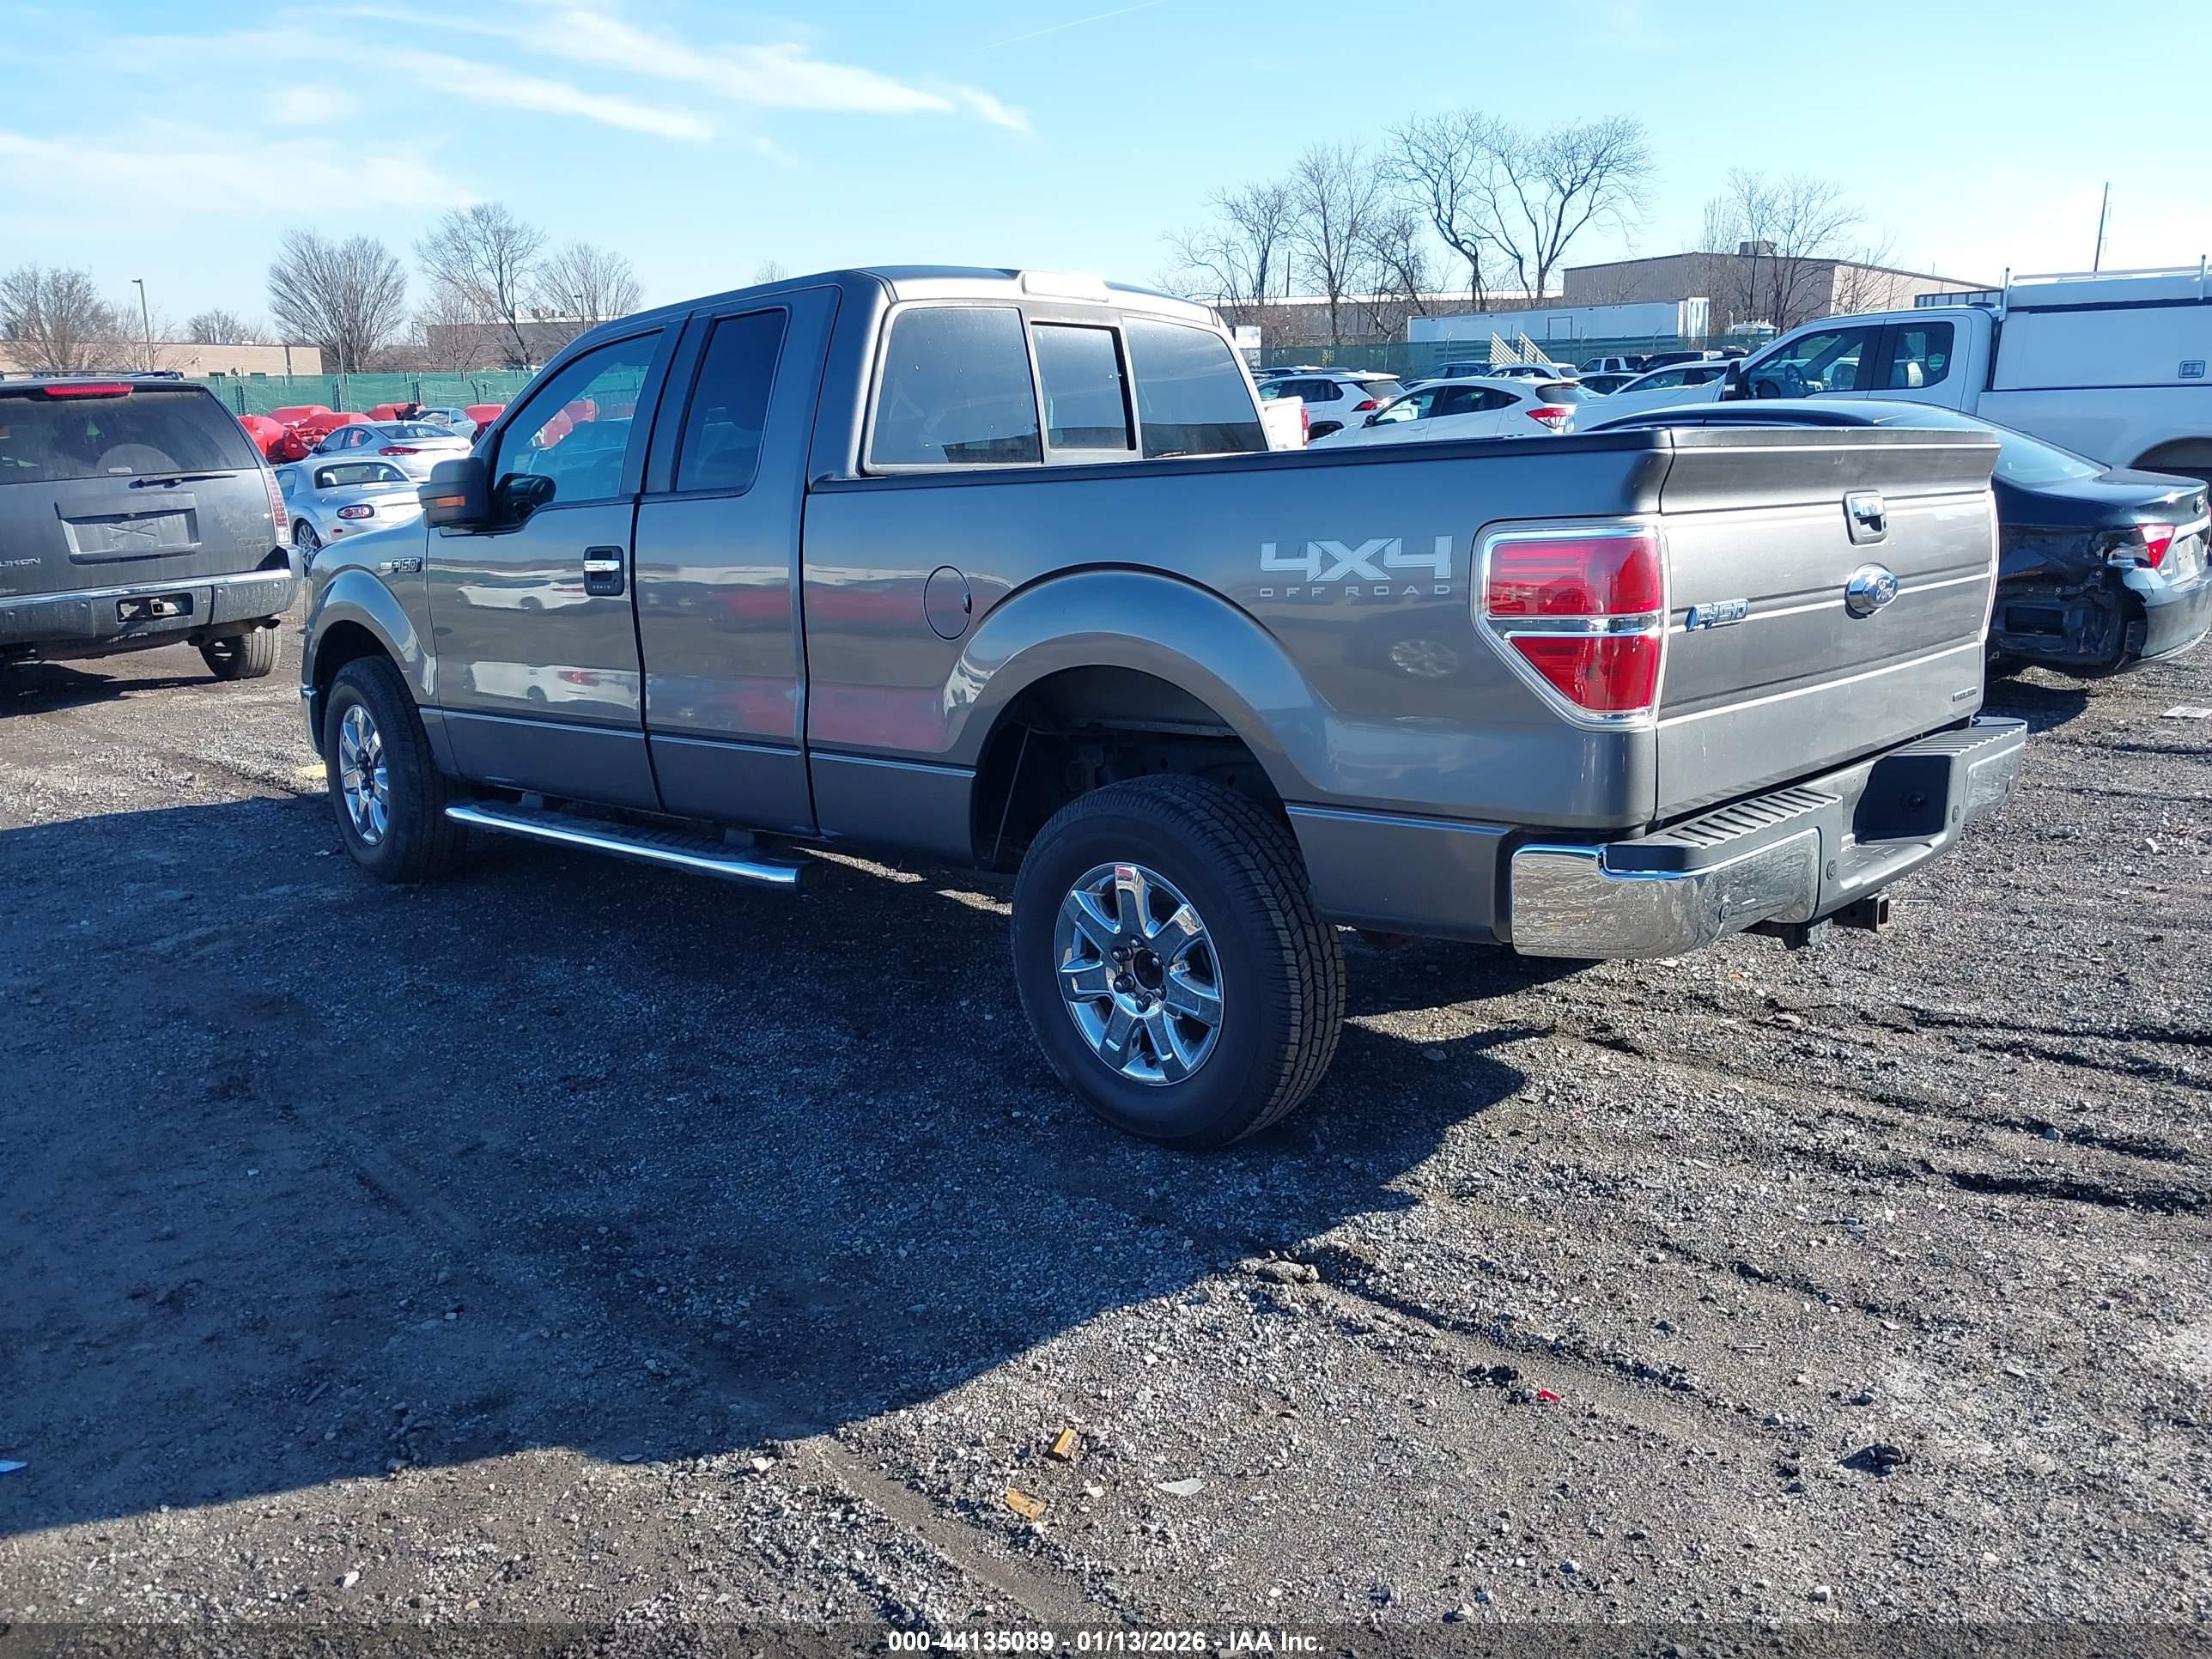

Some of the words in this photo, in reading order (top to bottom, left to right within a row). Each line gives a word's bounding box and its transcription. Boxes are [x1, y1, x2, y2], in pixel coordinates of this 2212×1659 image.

[1260, 535, 1453, 582] 4X4
[1259, 586, 1326, 598] OFF
[1345, 584, 1451, 598] ROAD
[1875, 578, 1896, 601] Ford
